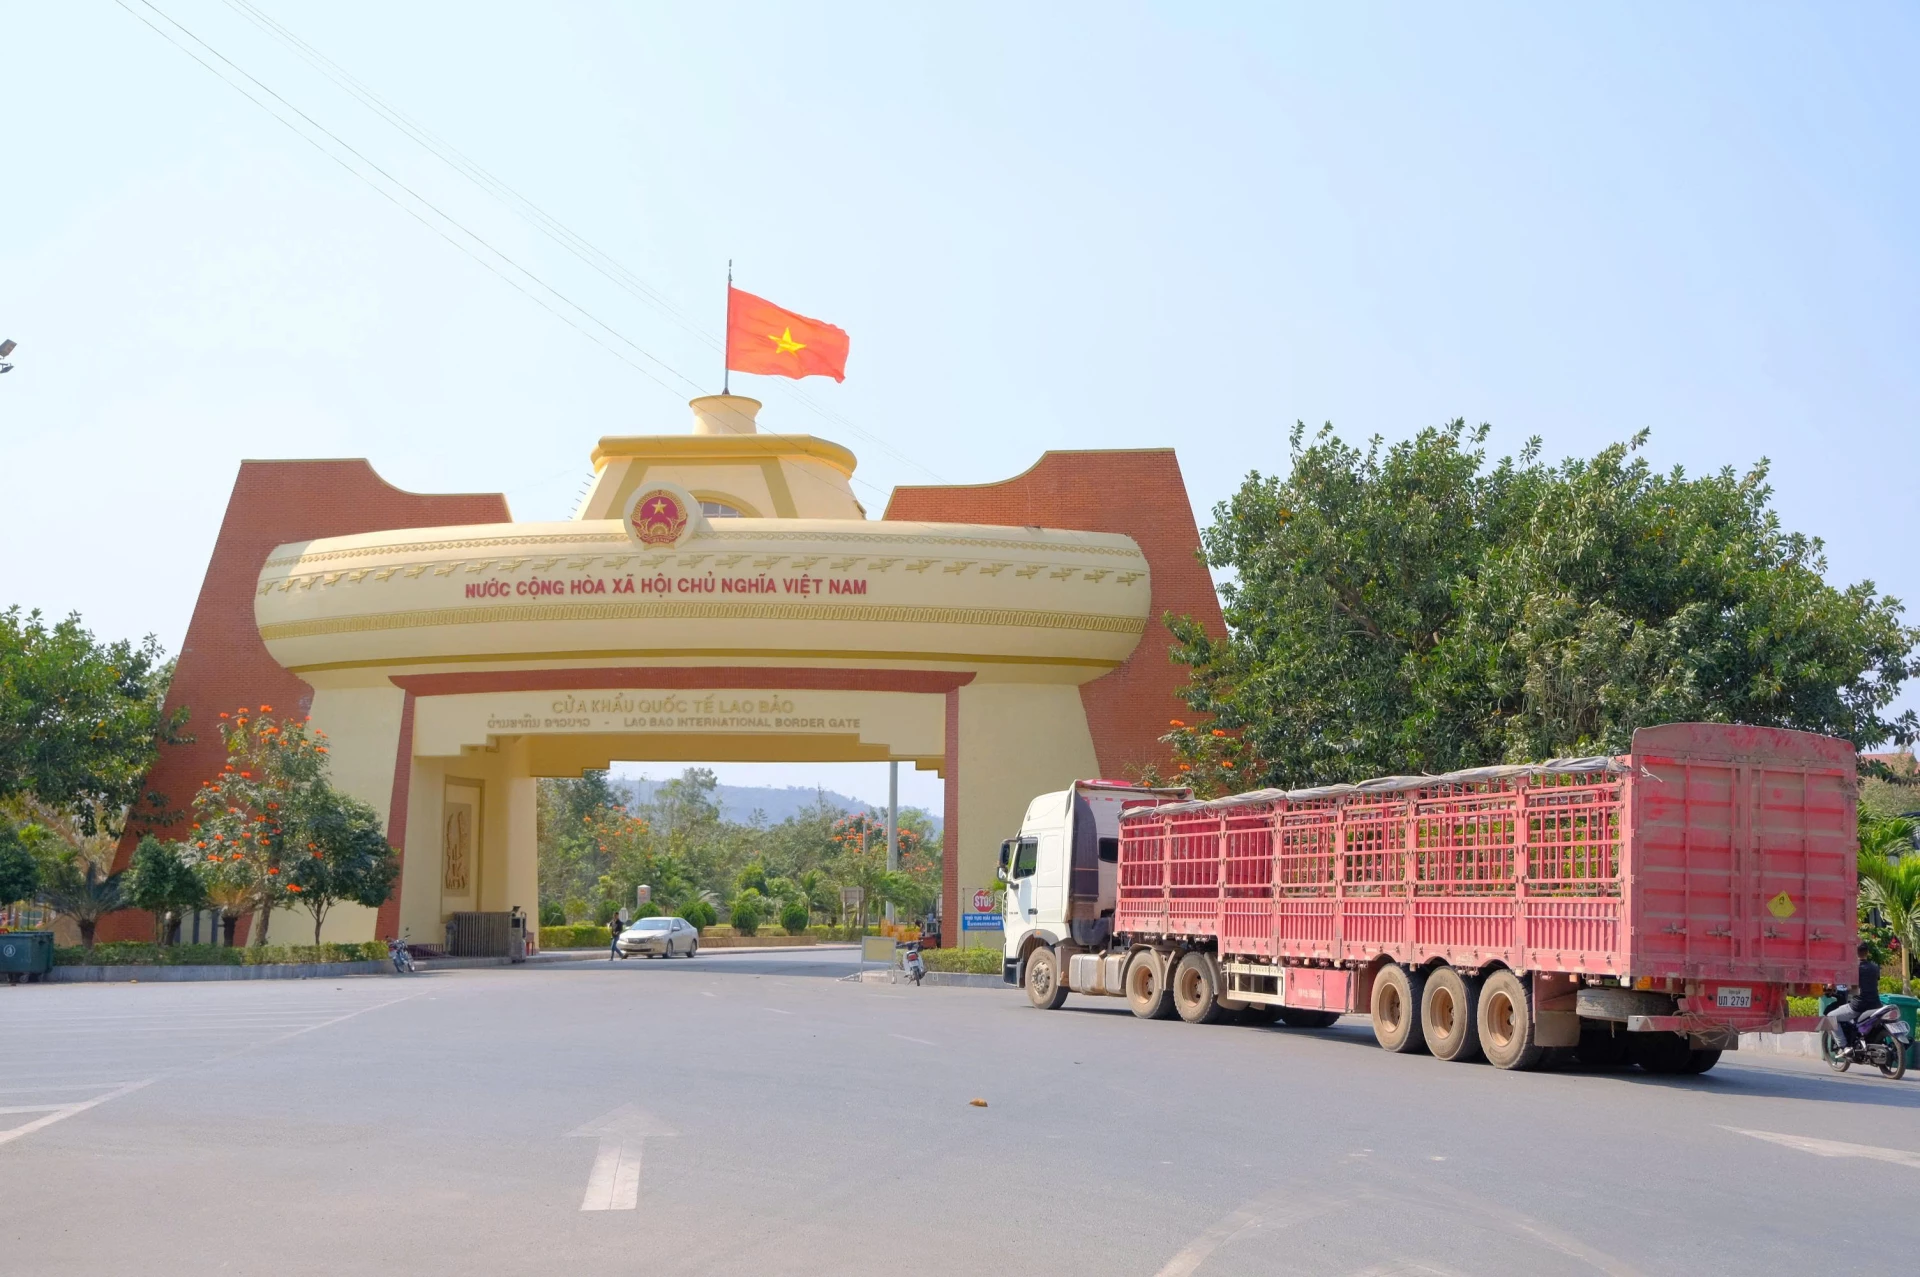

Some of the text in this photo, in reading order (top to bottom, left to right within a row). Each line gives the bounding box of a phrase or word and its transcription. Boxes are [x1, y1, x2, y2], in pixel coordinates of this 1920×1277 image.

[465, 571, 867, 600] NƯỚC CỘNG HÒA XÃ HỘI CHỦ NGHĨA VIỆT NAM
[552, 692, 795, 714] CỬA KHẨU QUỐC TẾ LAO BẢO
[624, 717, 646, 727] LAO
[650, 717, 673, 727] BAO
[677, 717, 771, 728] INTERNATIONAL
[775, 717, 825, 728] BORDER
[828, 718, 860, 728] GATE
[974, 895, 993, 907] STOP
[1731, 996, 1749, 1006] 2797
